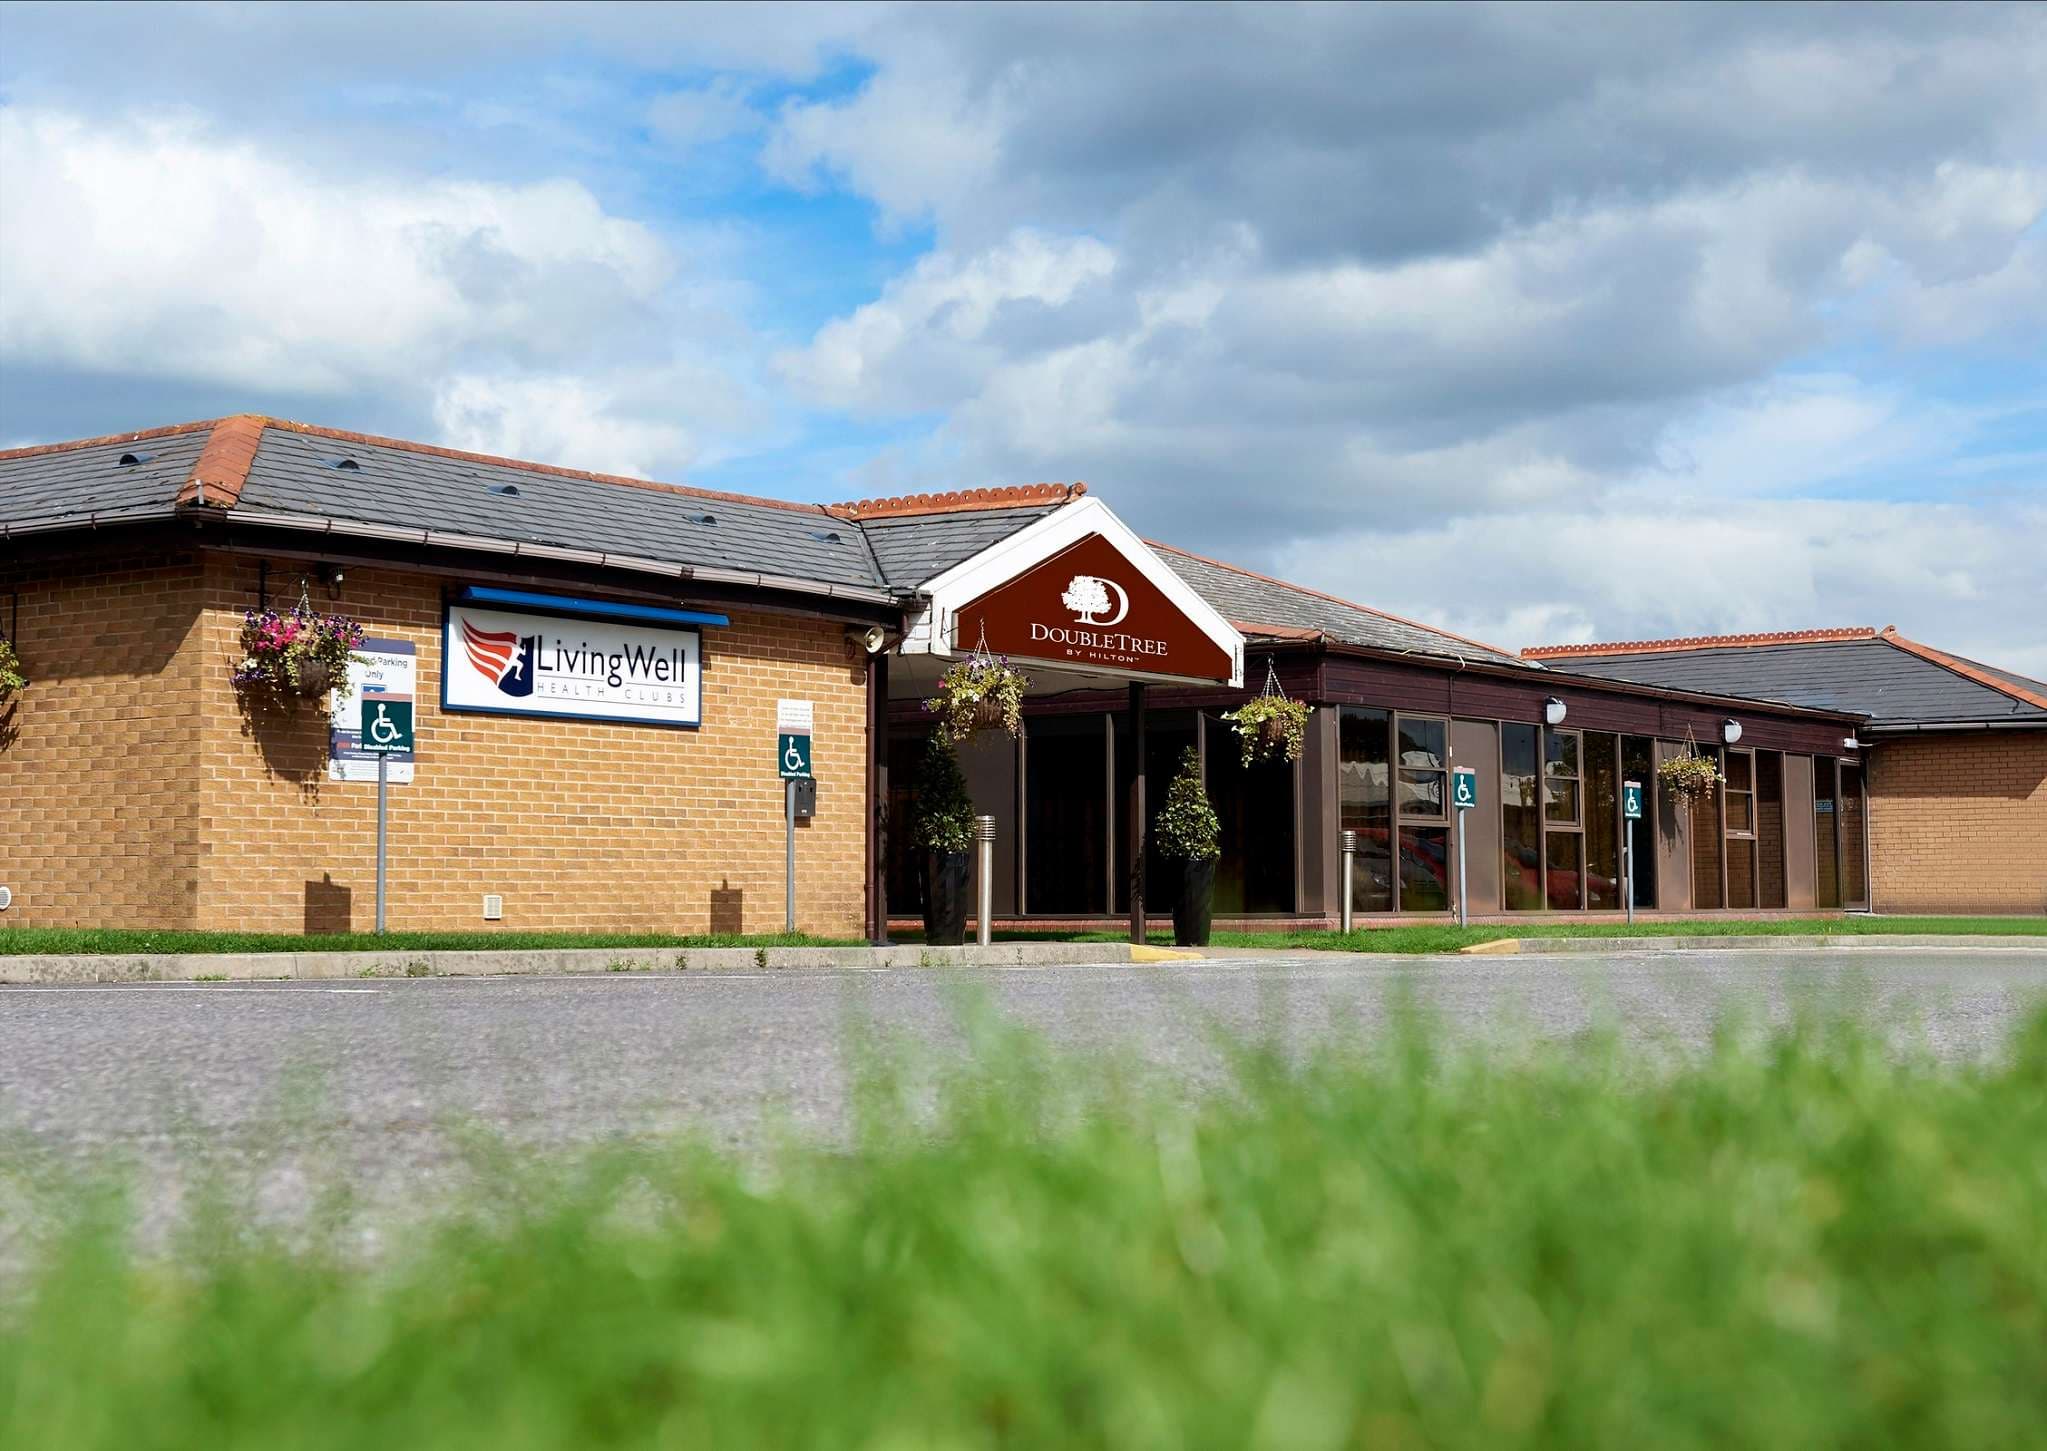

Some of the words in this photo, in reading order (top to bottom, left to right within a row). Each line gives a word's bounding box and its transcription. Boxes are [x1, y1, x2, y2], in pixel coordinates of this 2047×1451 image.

[1066, 648, 1082, 656] BY
[378, 656, 408, 668] Parking
[537, 634, 686, 688] LivingWell
[537, 682, 605, 697] HEALTH
[624, 689, 685, 704] CLUBS
